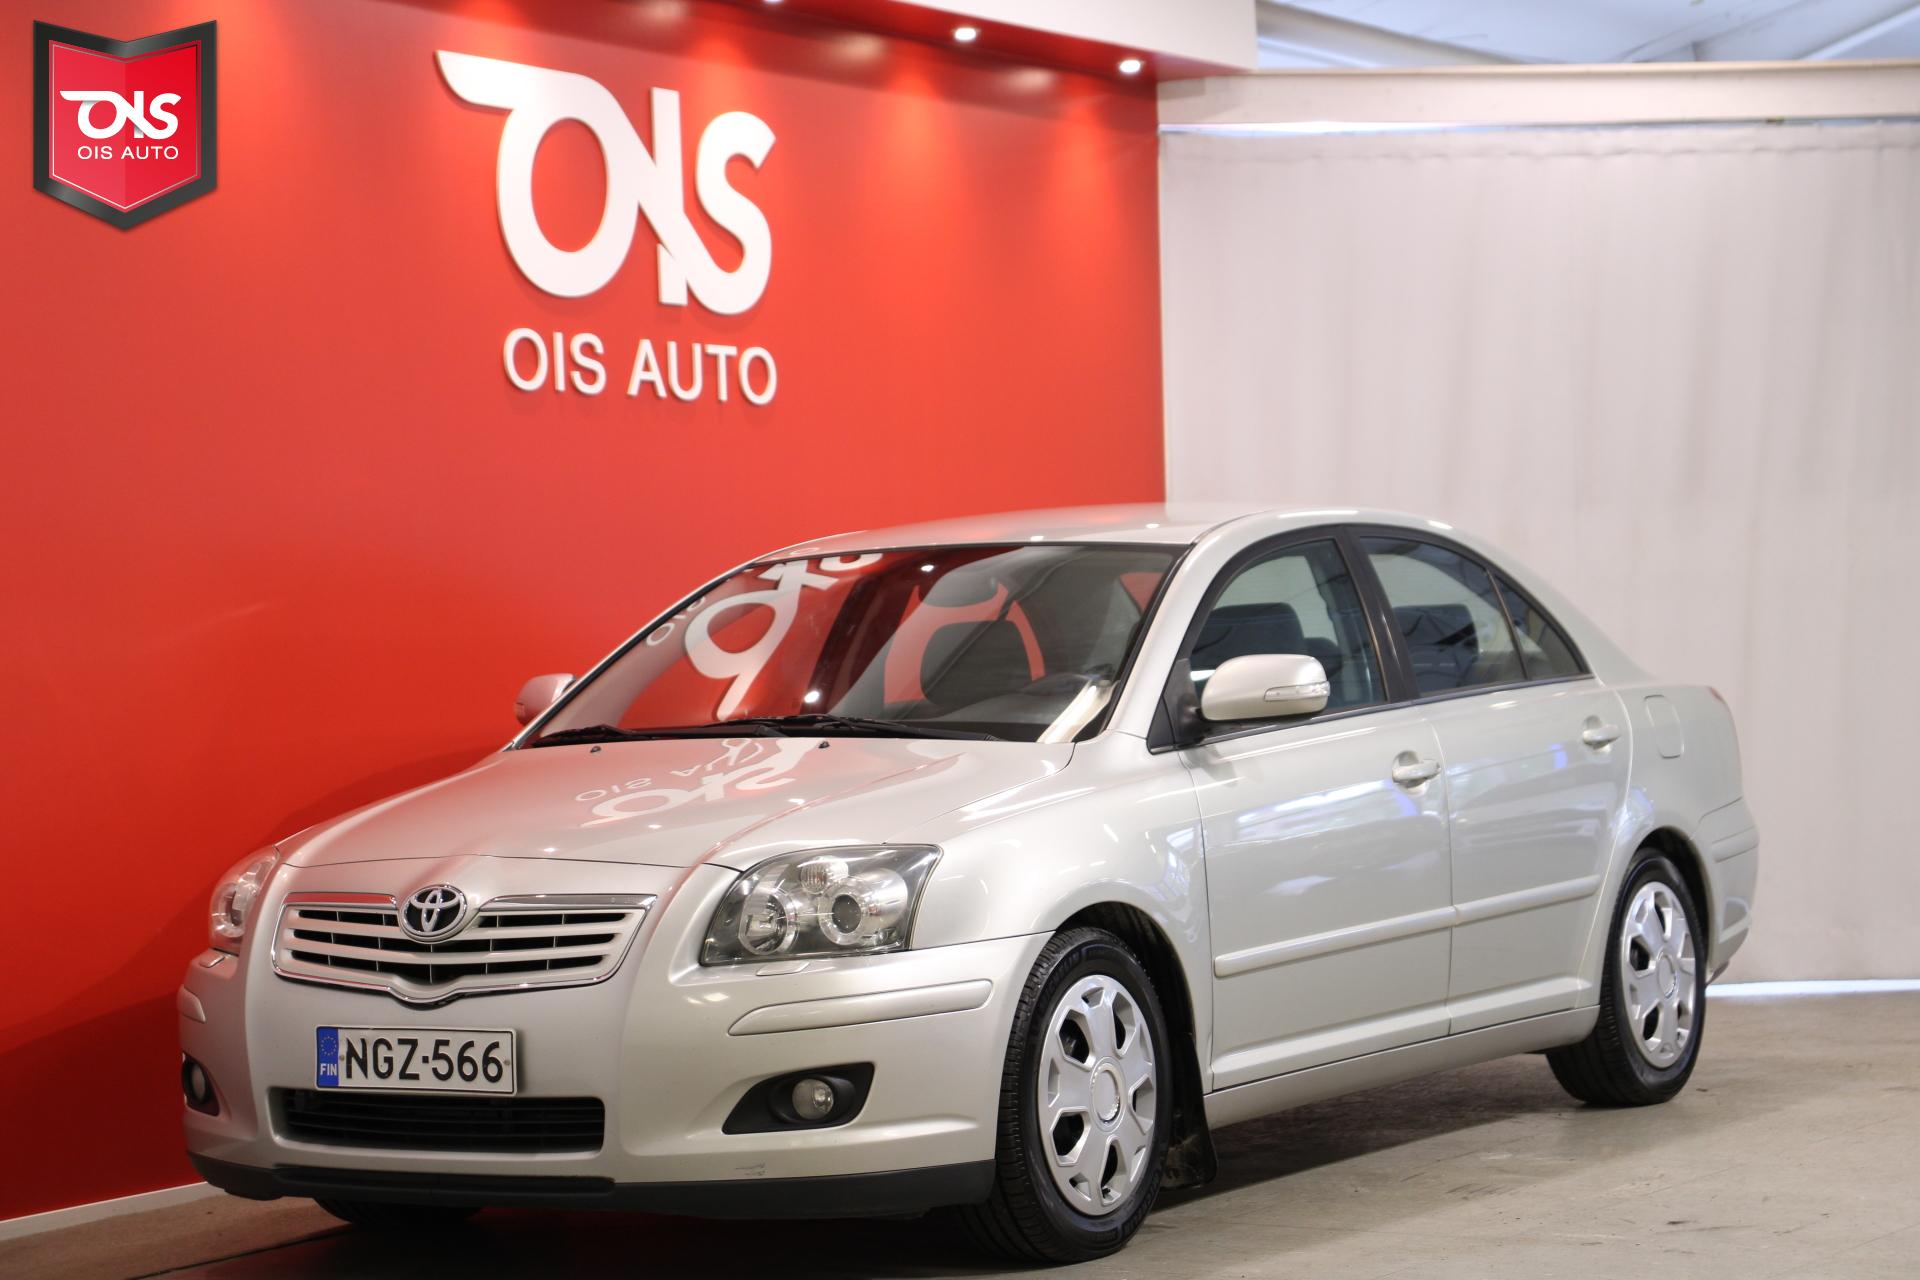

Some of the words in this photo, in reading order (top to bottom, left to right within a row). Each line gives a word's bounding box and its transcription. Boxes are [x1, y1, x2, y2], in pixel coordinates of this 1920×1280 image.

[503, 327, 606, 395] OIS
[627, 339, 777, 405] AUTO
[320, 1063, 337, 1076] FIN
[345, 1037, 503, 1083] NGZ-566
